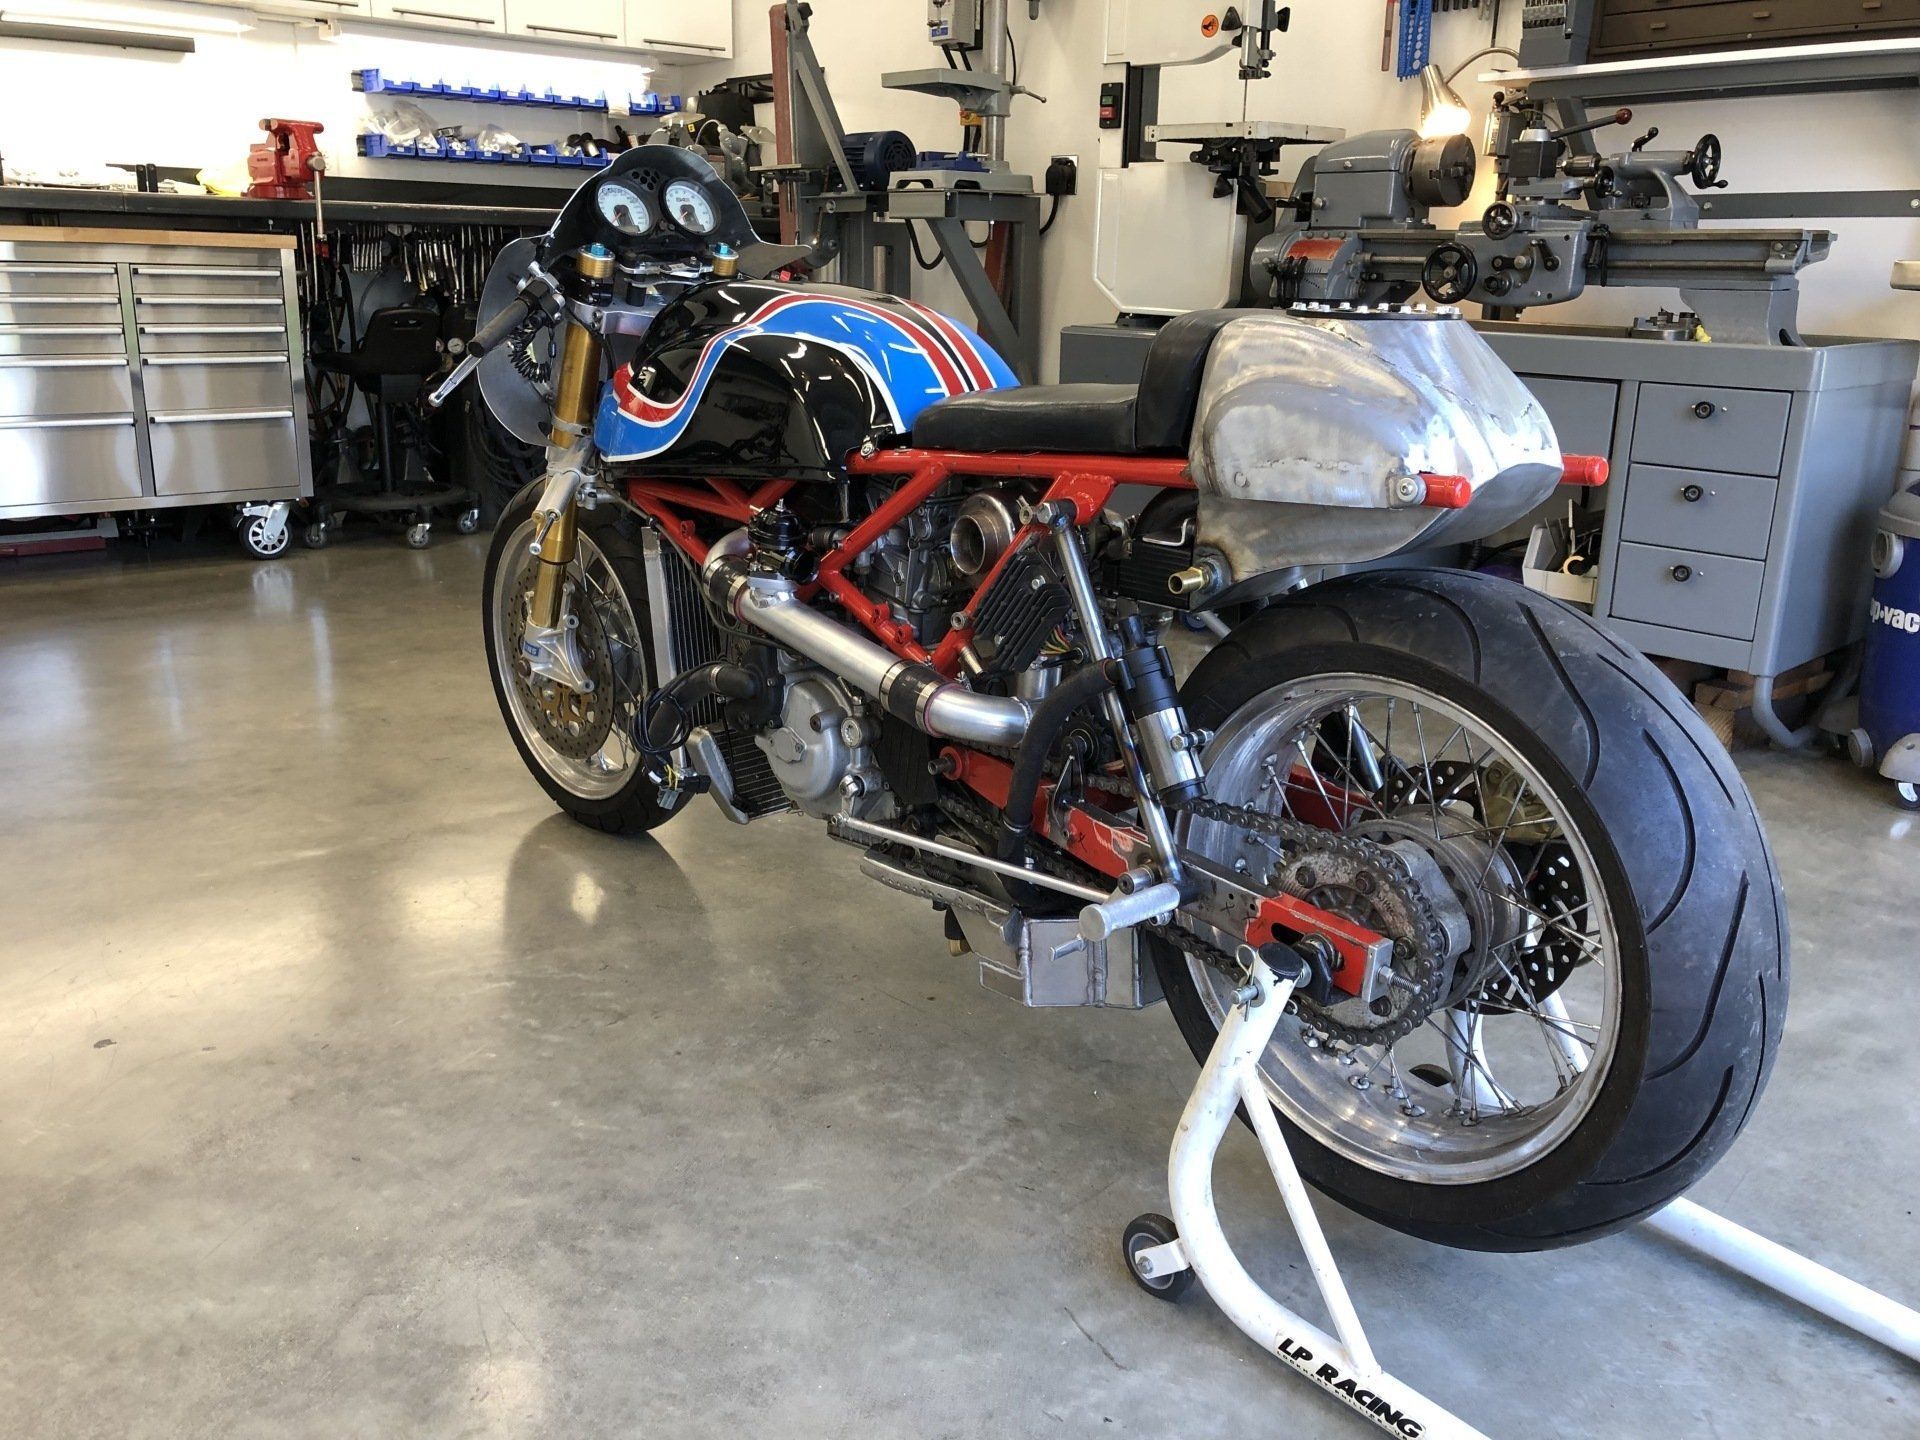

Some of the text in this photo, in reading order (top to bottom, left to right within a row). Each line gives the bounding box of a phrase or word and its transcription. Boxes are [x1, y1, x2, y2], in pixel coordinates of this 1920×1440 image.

[1277, 1350, 1328, 1386] LOCKHART
[1278, 1337, 1422, 1438] LP RACING
